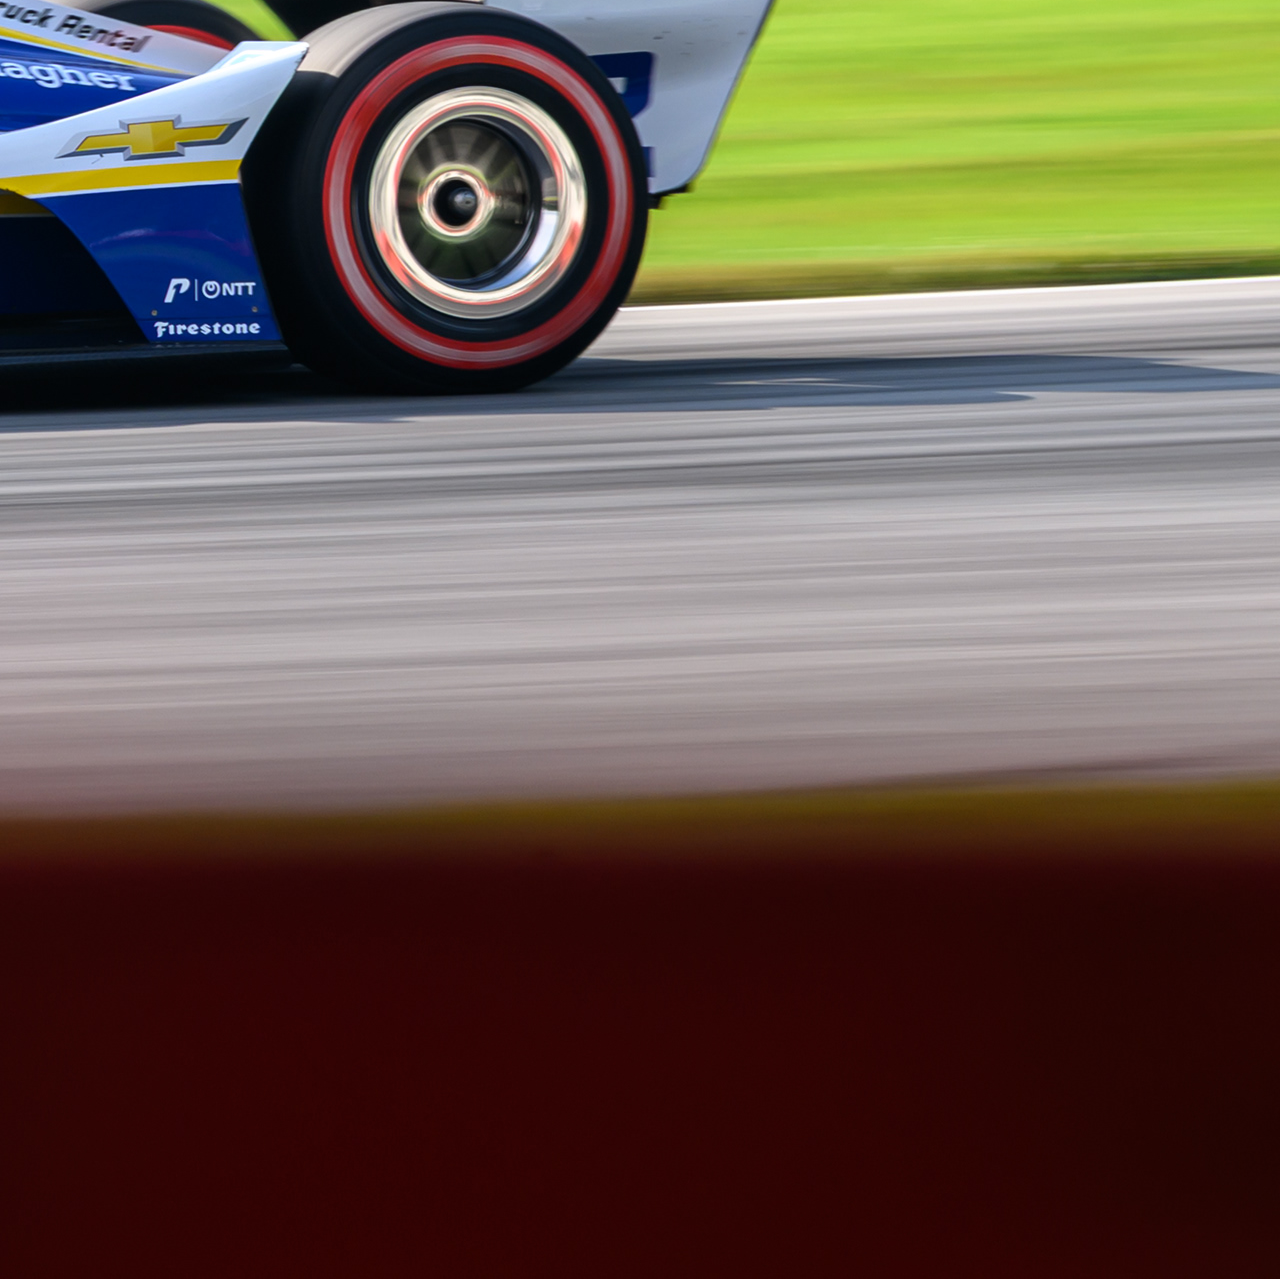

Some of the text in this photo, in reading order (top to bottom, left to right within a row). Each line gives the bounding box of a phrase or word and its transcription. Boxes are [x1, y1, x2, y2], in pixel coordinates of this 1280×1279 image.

[54, 14, 152, 53] Rental
[222, 282, 256, 297] NTT
[154, 321, 261, 338] Firestone
